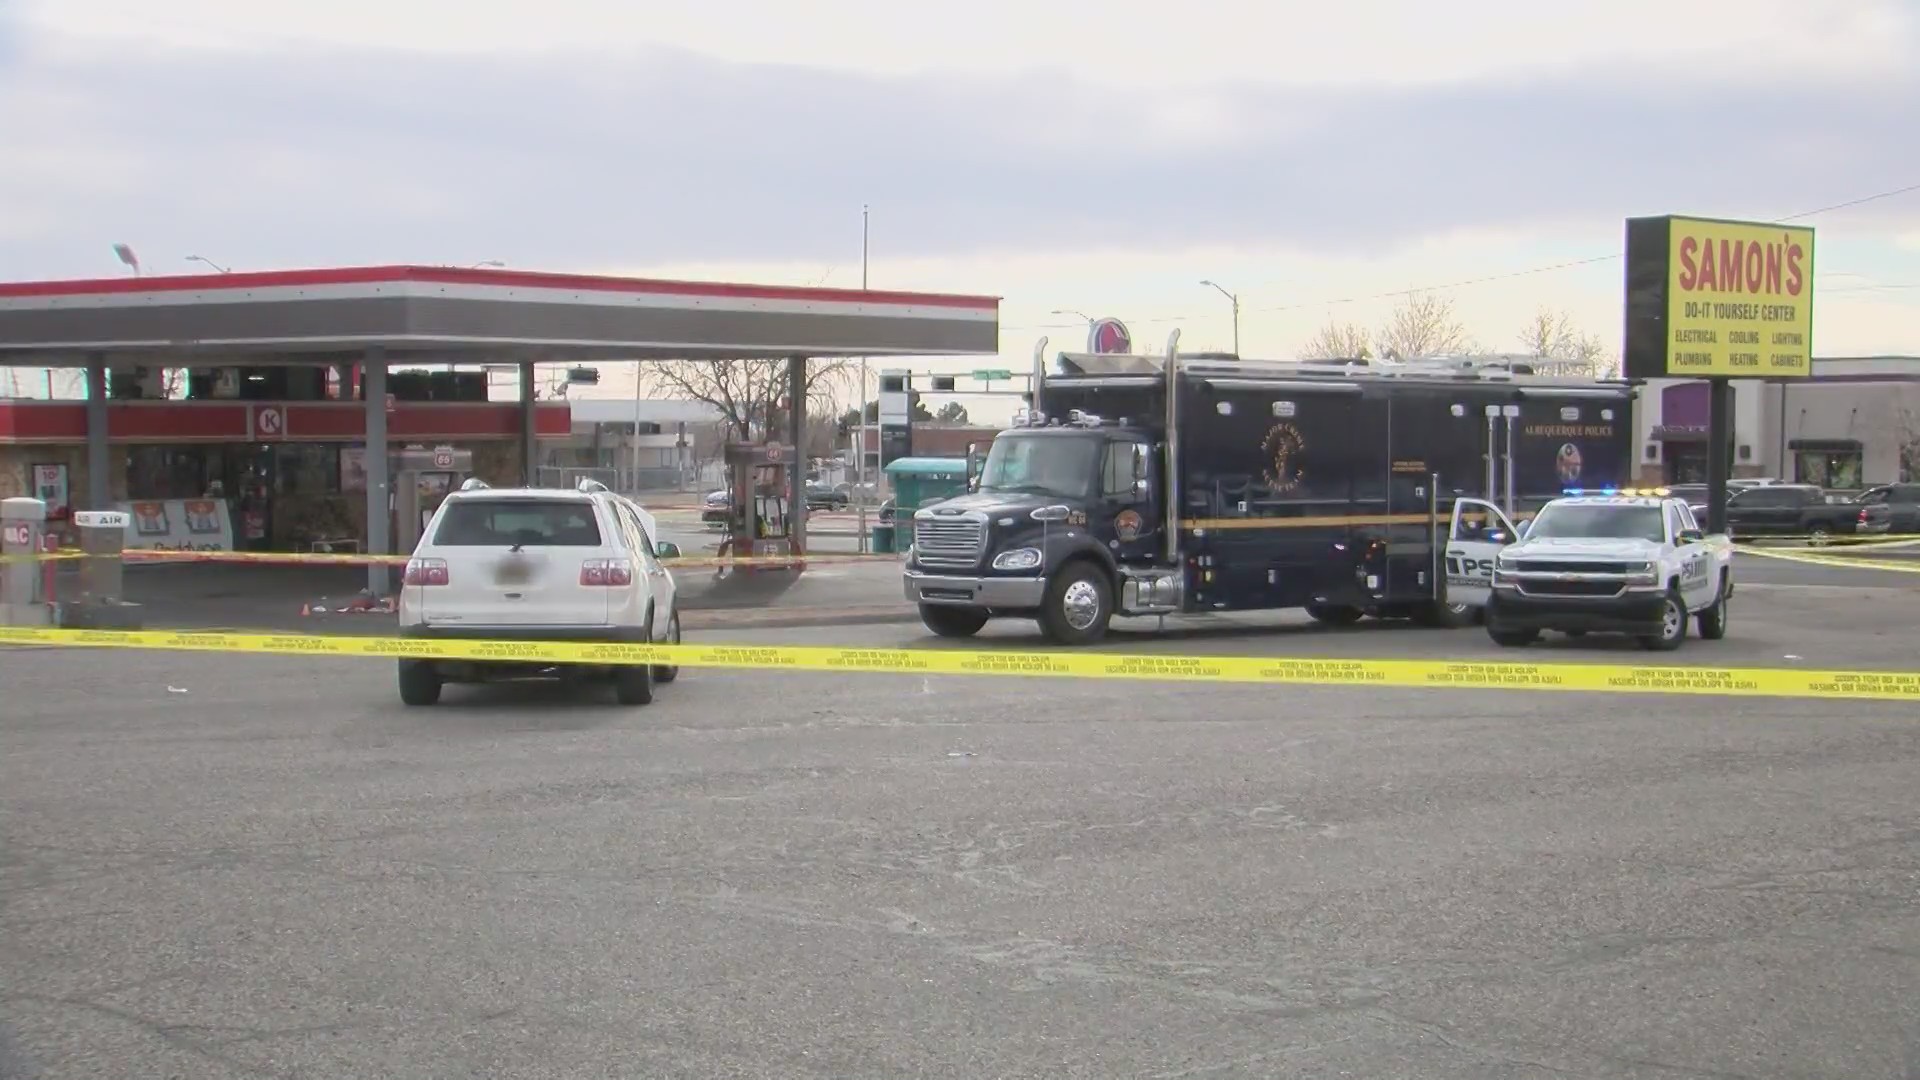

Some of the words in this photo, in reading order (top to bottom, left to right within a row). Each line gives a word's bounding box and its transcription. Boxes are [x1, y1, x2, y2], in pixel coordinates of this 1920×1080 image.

[1679, 232, 1804, 296] SAMON'S
[1684, 302, 1712, 318] DO-IT
[1713, 303, 1759, 320] YOURSELF
[1761, 305, 1796, 322] CENTER
[1674, 329, 1718, 344] ELECTRICAL
[1728, 331, 1760, 344] COOLING
[1771, 332, 1803, 345] LIGHTING
[1674, 352, 1712, 366] PLUMBING
[1729, 352, 1759, 366] HEATING
[1770, 353, 1804, 368] CABINETS
[263, 412, 276, 428] K
[1584, 425, 1614, 437] POLICE
[99, 516, 122, 524] AIR
